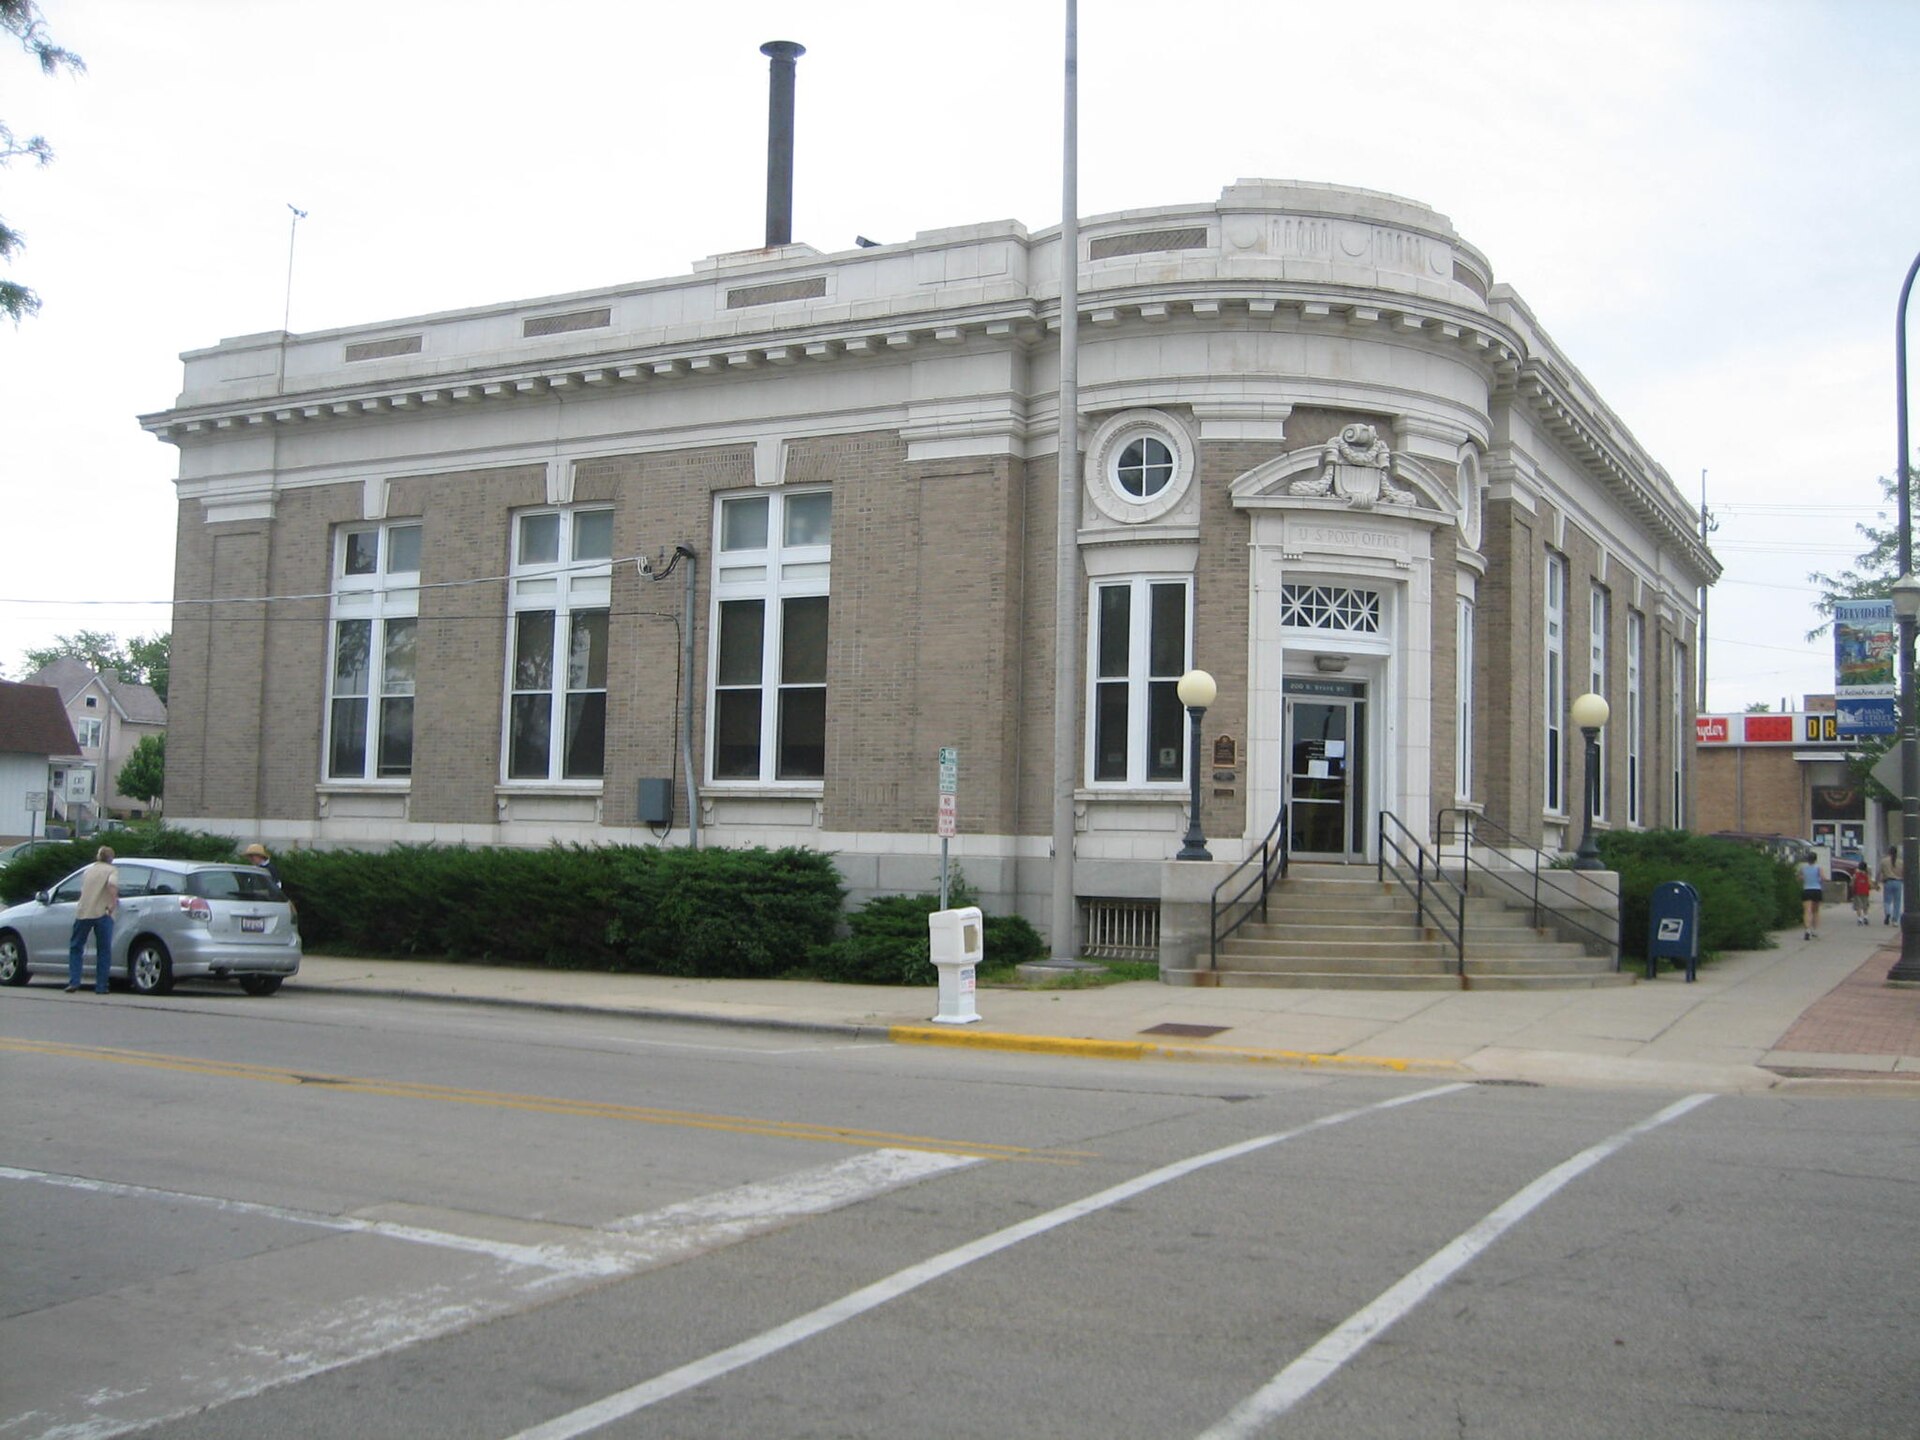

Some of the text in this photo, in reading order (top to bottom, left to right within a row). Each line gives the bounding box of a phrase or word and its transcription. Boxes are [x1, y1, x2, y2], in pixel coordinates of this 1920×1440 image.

[1298, 527, 1401, 548] U S POST OFFICE
[1835, 605, 1892, 619] BELVIDERE
[1290, 682, 1304, 690] 200
[1807, 719, 1849, 738] DR
